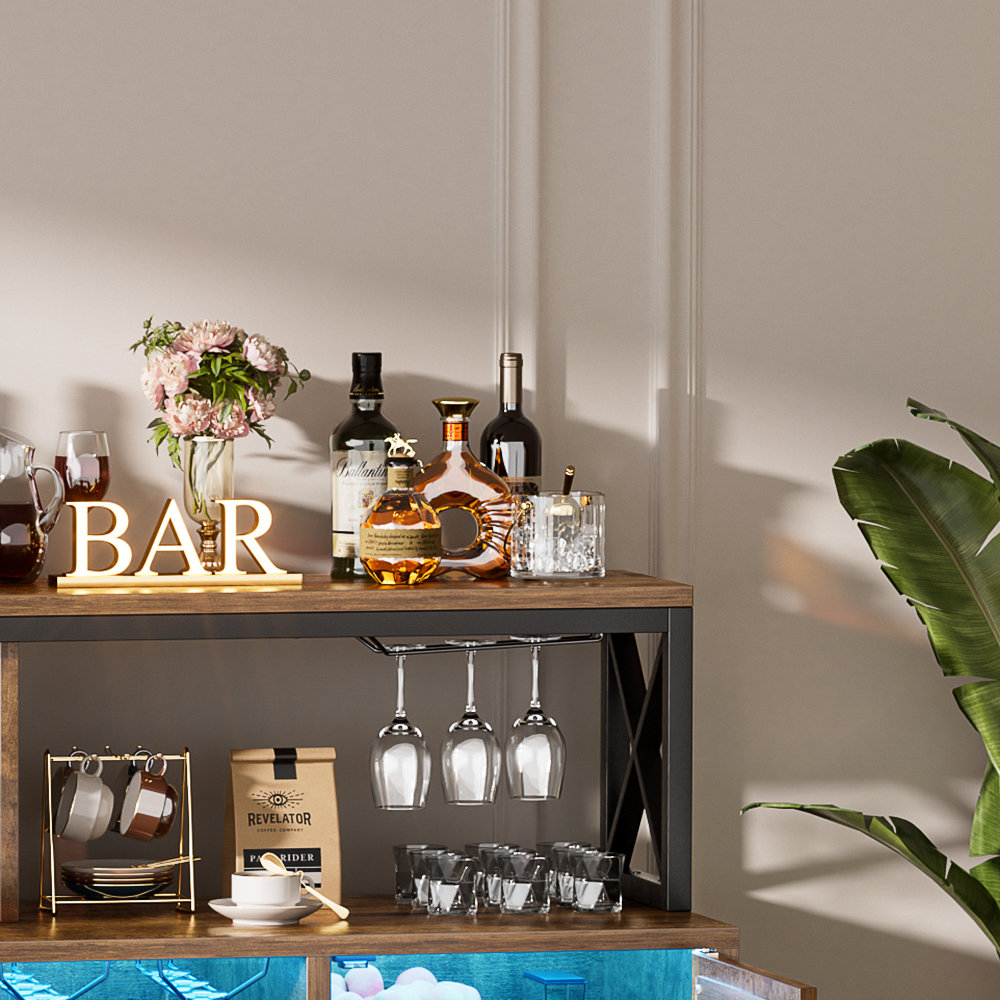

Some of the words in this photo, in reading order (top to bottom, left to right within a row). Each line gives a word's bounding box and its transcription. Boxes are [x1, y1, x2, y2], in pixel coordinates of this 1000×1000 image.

[336, 456, 388, 478] Ballantin
[65, 498, 288, 577] BAR
[247, 812, 312, 827] REVELATOR
